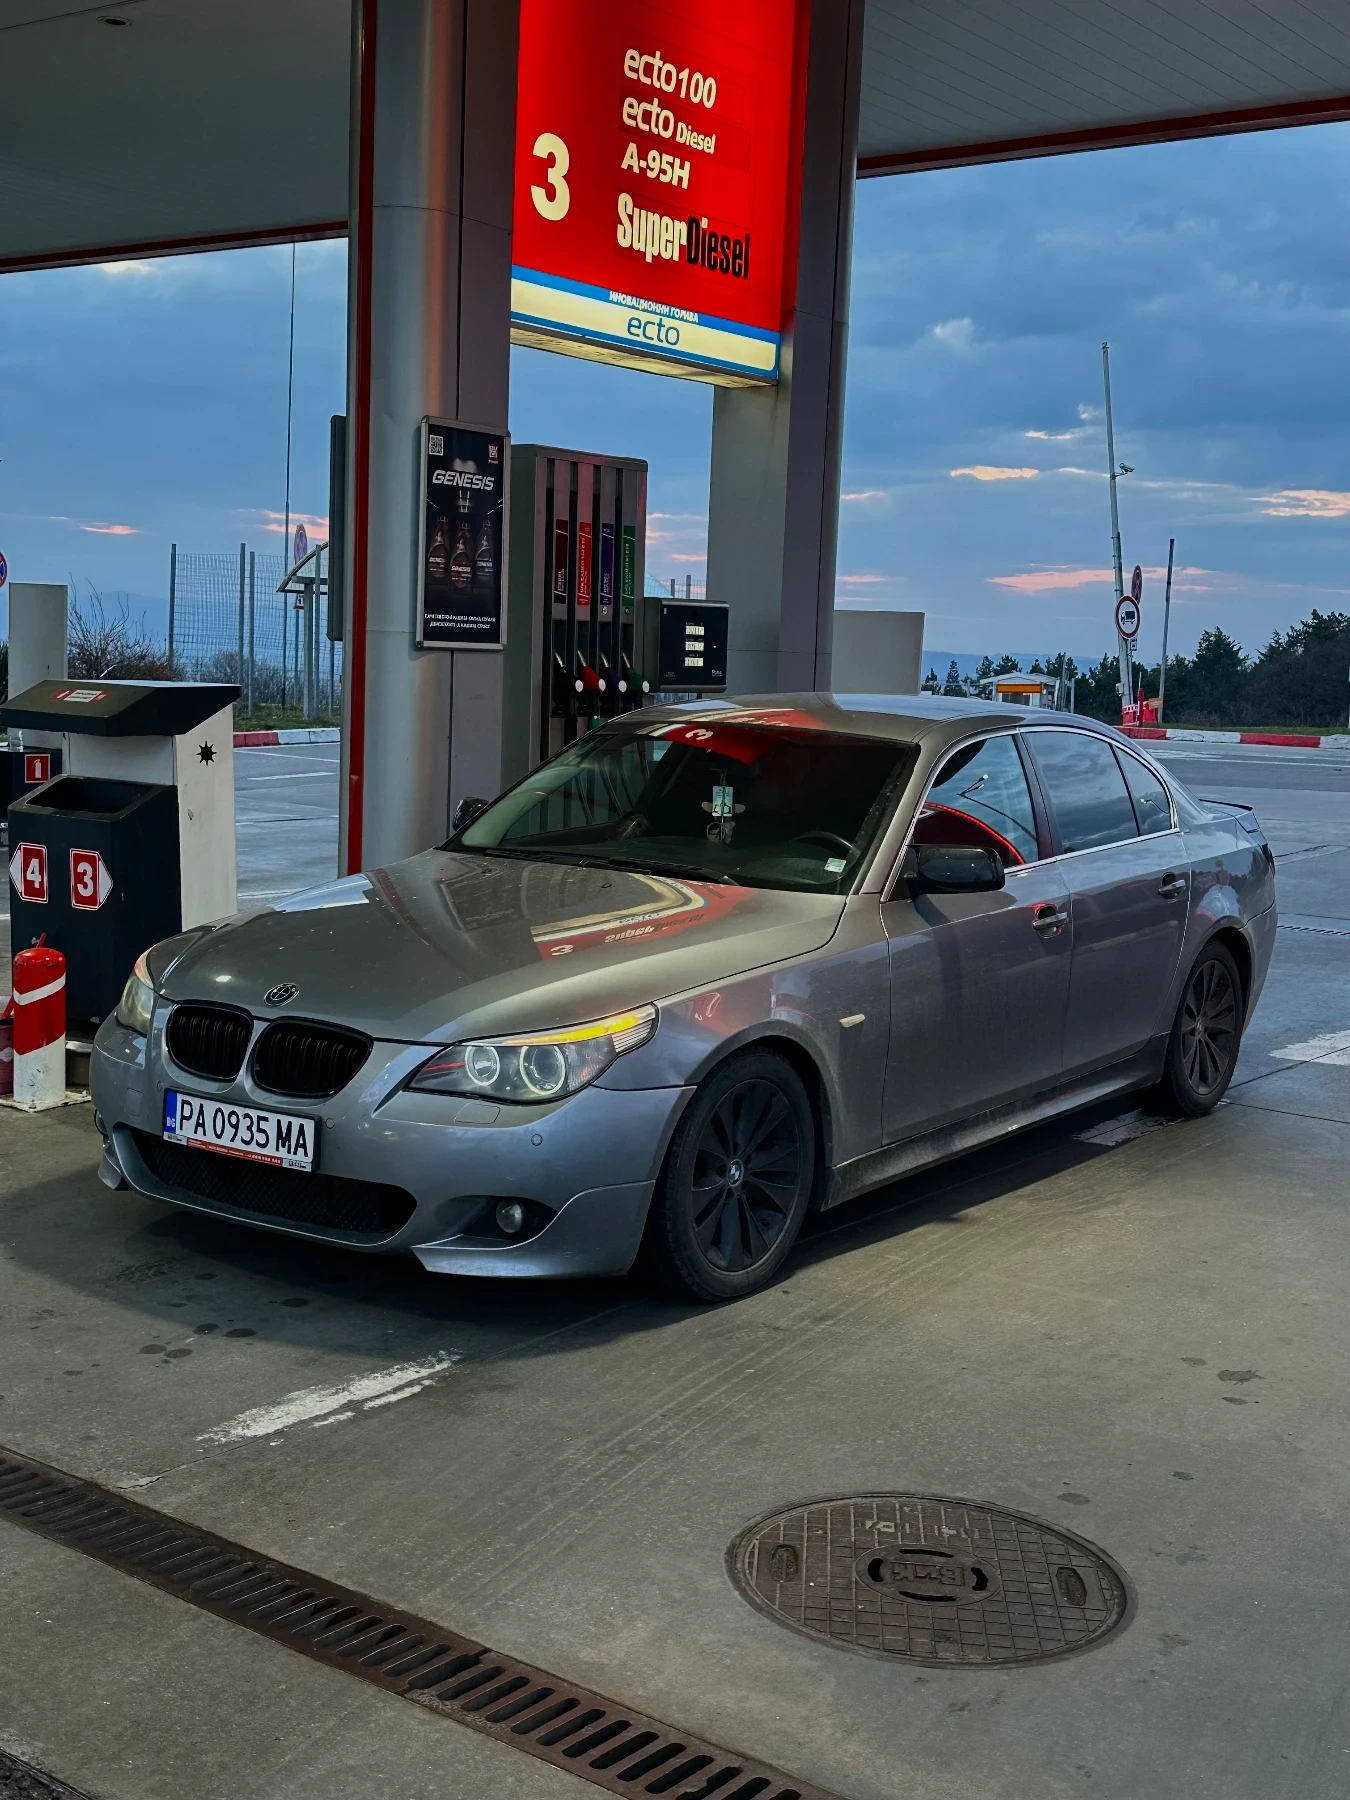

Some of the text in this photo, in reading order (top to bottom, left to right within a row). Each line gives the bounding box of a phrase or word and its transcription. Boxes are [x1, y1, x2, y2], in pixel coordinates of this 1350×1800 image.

[622, 97, 716, 155] ecto Diesel
[531, 132, 570, 221] 3
[620, 142, 691, 189] A-95H
[609, 290, 699, 324] ИНОВАЦИОННИ ГОРИВА
[627, 316, 681, 346] ecto
[432, 469, 495, 491] GENESIS
[26, 858, 42, 889] 4
[76, 861, 95, 898] 3
[166, 1116, 176, 1128] BG
[179, 1098, 309, 1158] PA 0935 MA
